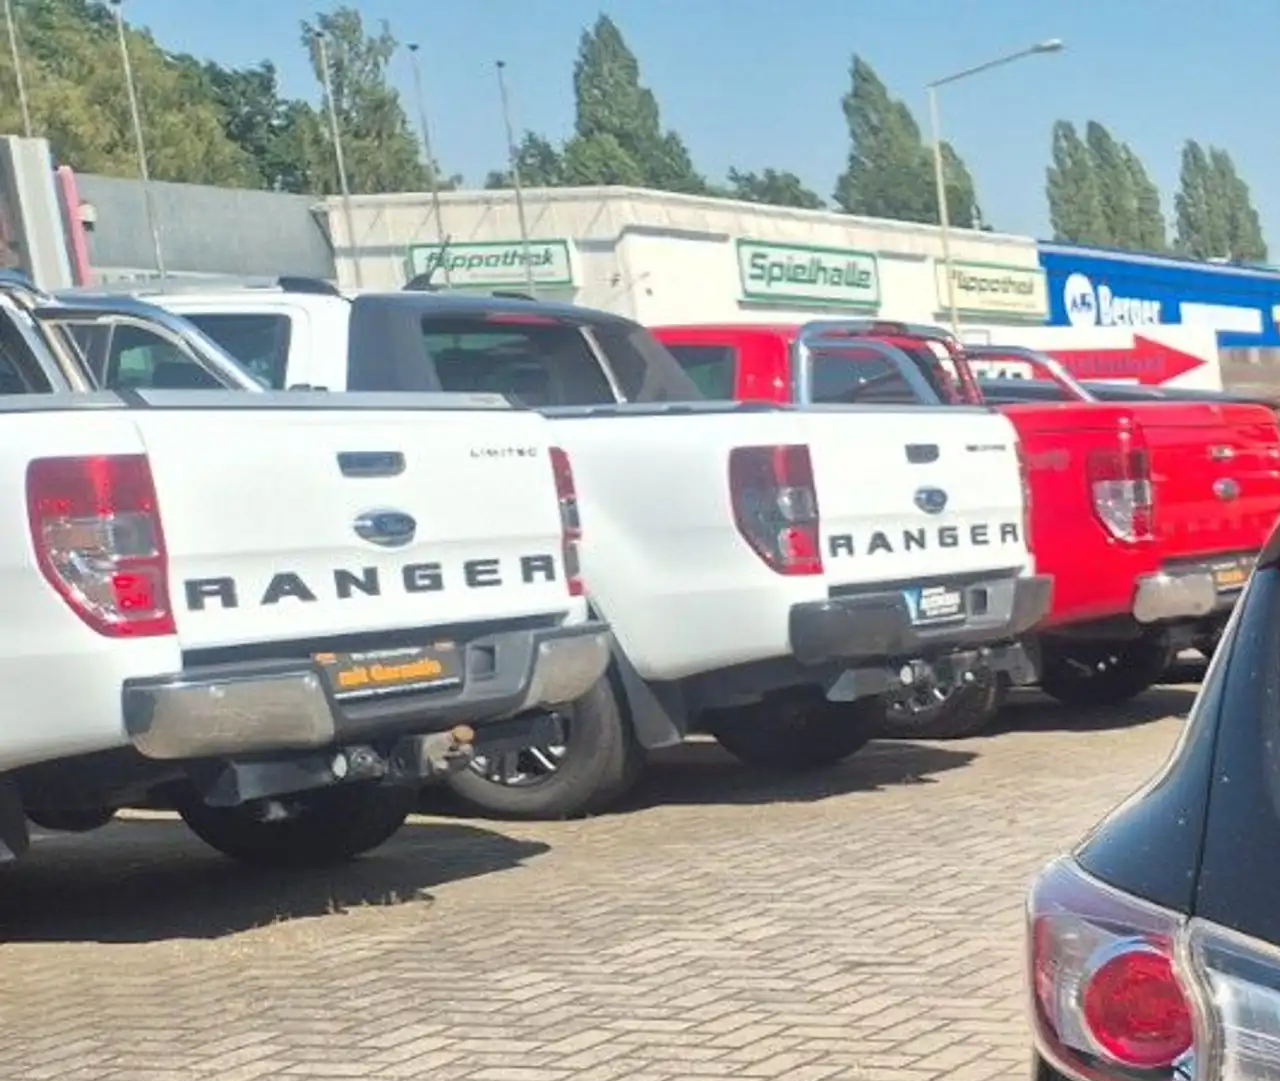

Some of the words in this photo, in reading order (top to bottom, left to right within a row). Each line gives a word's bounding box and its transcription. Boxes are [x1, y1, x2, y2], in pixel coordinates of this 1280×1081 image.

[749, 253, 871, 289] Spielhalle
[827, 522, 1019, 558] RANGER
[184, 553, 557, 612] RANGER
